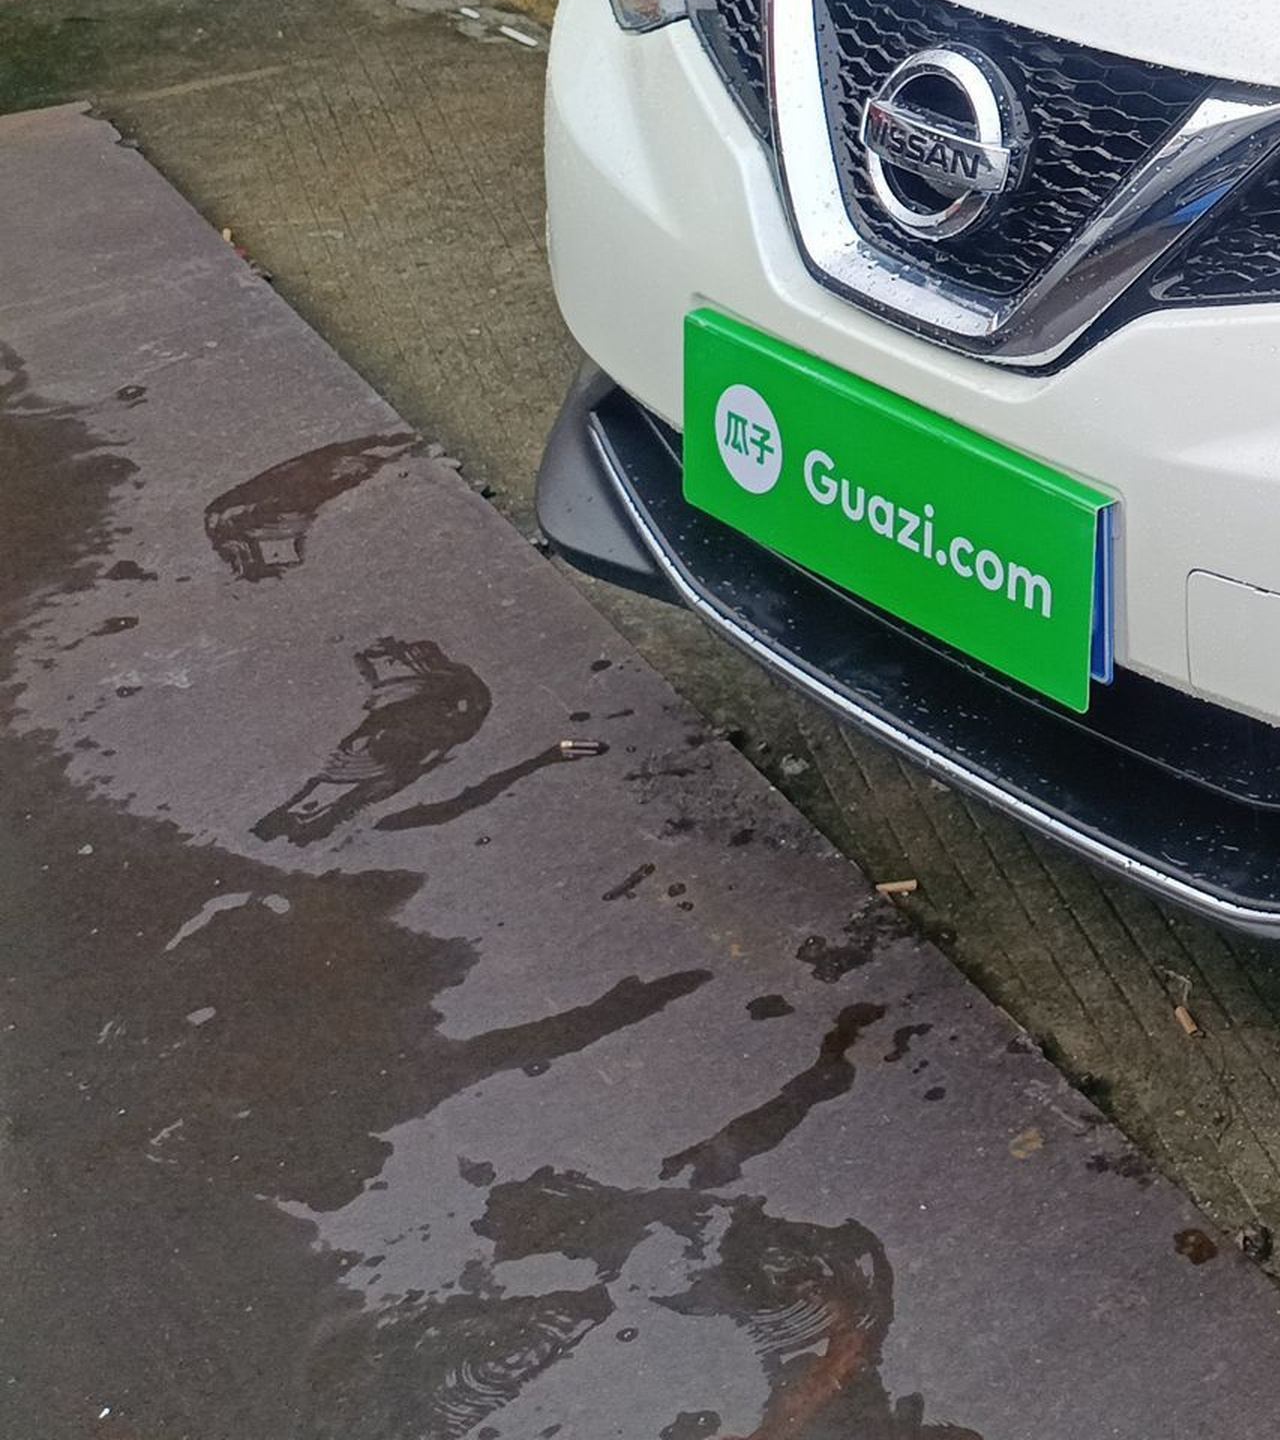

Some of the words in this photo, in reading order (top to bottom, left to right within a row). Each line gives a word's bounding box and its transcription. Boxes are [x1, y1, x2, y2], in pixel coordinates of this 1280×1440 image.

[868, 112, 981, 180] NISSAN
[724, 410, 774, 465] 瓜子
[803, 448, 1053, 619] Guazi.com
